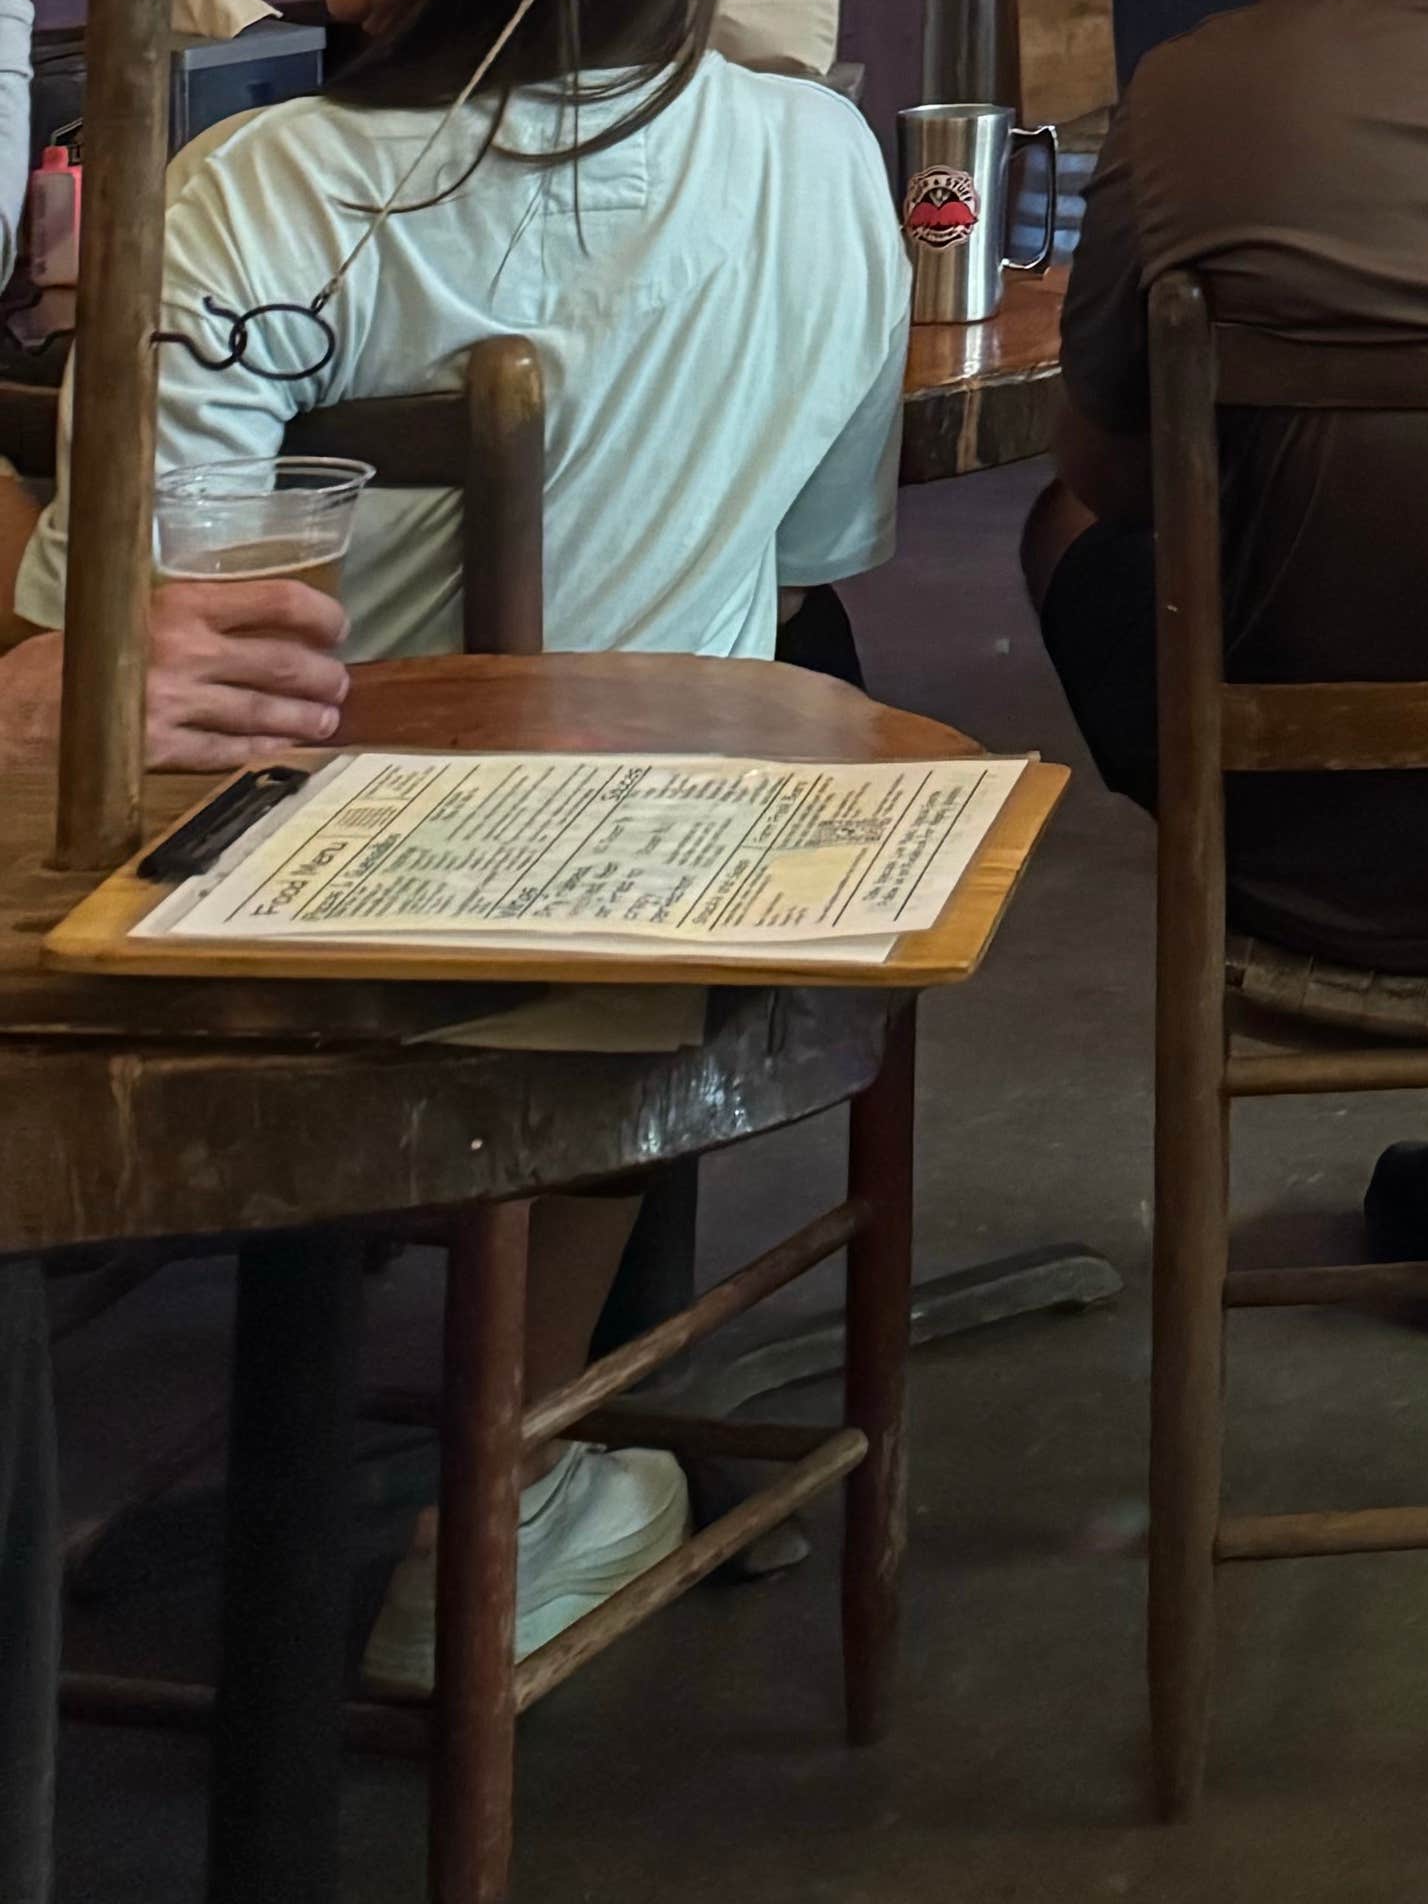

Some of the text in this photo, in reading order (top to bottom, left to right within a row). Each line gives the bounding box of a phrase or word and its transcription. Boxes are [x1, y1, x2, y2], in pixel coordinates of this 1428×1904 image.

[599, 768, 643, 801] Sauces
[251, 842, 348, 916] Food Menu
